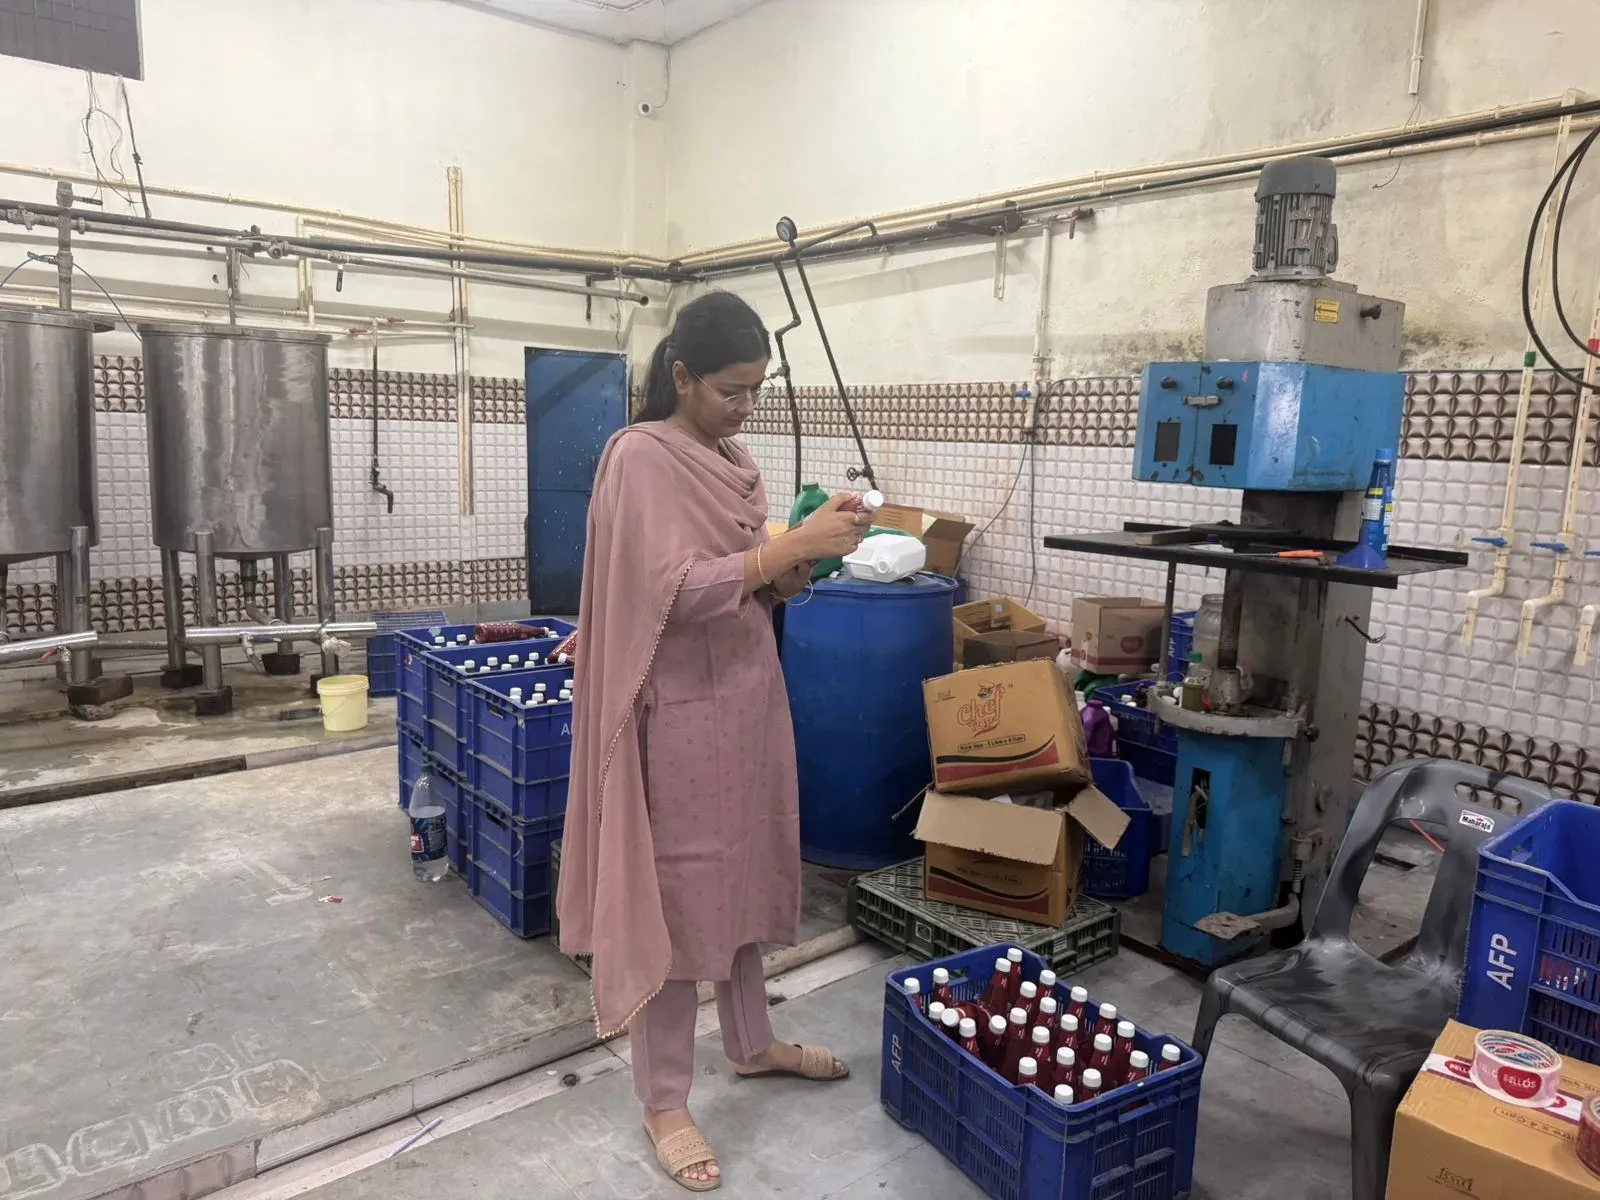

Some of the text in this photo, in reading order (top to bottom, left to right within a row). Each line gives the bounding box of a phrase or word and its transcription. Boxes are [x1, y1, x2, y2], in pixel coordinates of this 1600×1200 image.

[957, 682, 1005, 726] Chef
[1486, 933, 1518, 991] AFP
[891, 1033, 902, 1074] AFP
